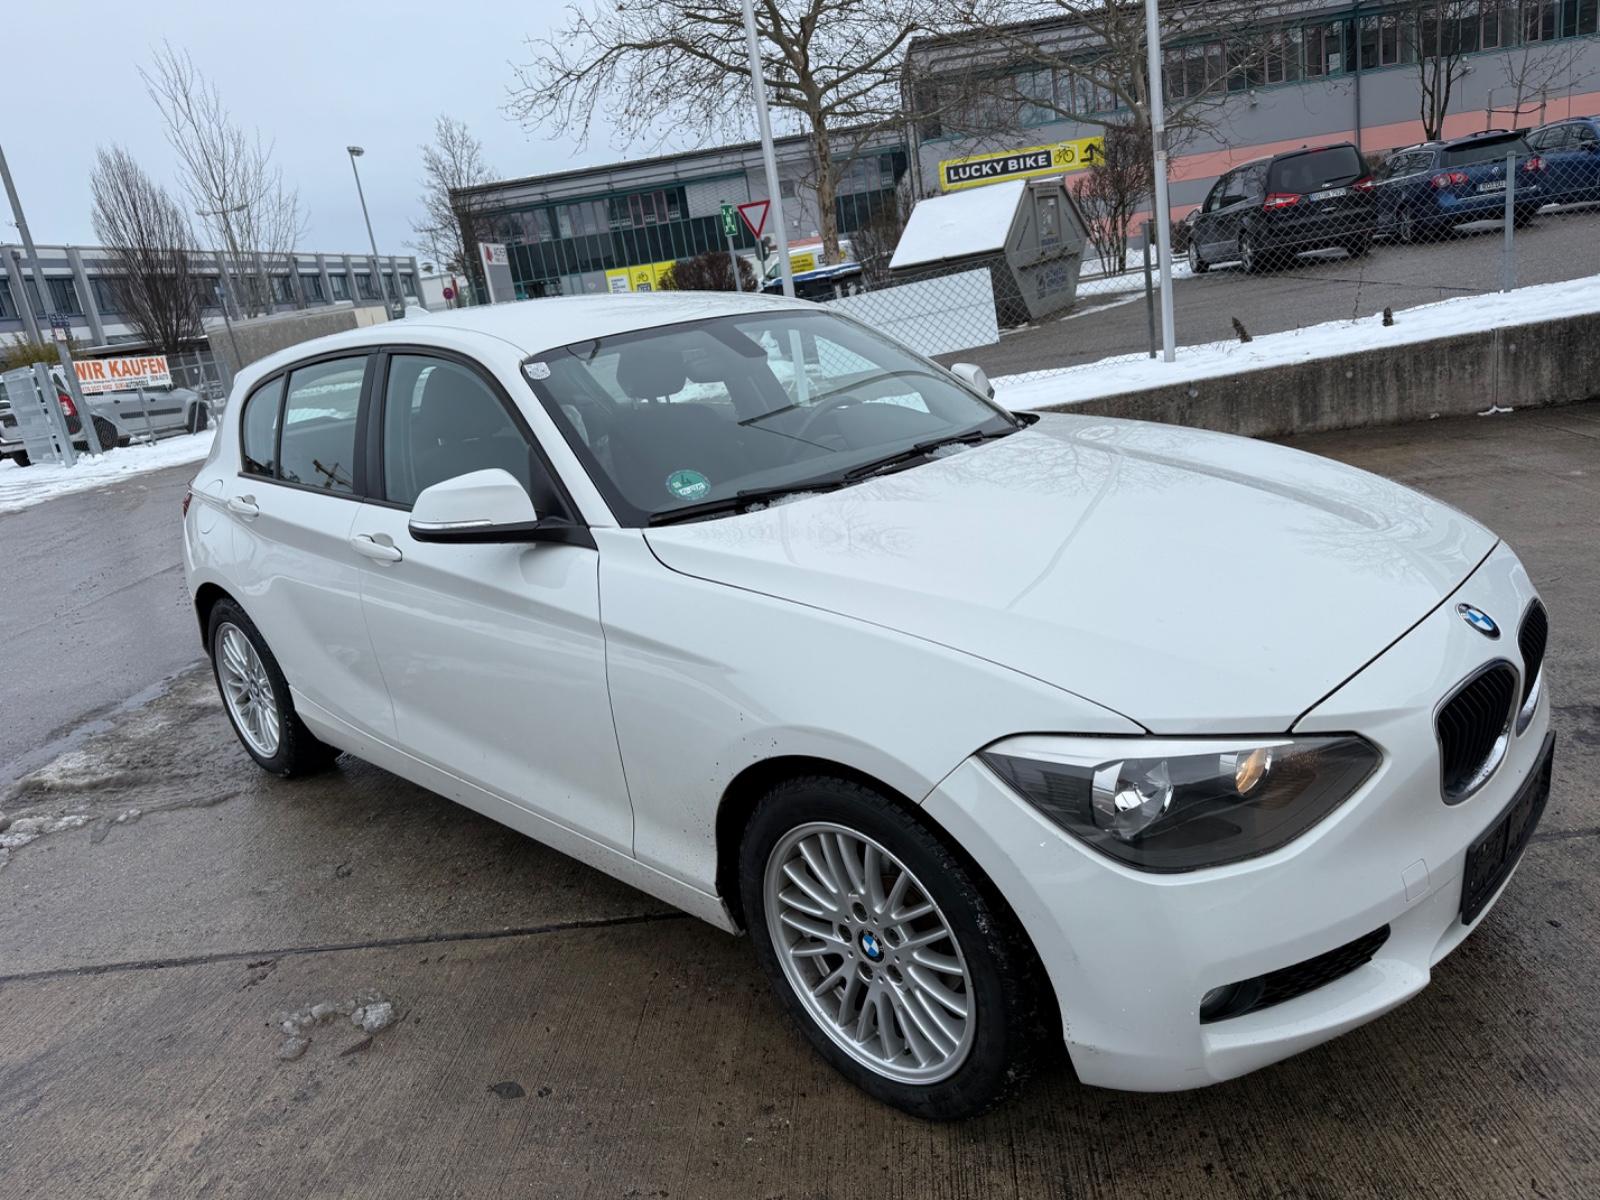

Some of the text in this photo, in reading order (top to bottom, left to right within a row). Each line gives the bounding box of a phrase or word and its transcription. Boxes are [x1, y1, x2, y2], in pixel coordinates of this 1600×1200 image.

[950, 155, 1048, 180] LUCKY BIKE
[108, 358, 167, 377] KAUFEN
